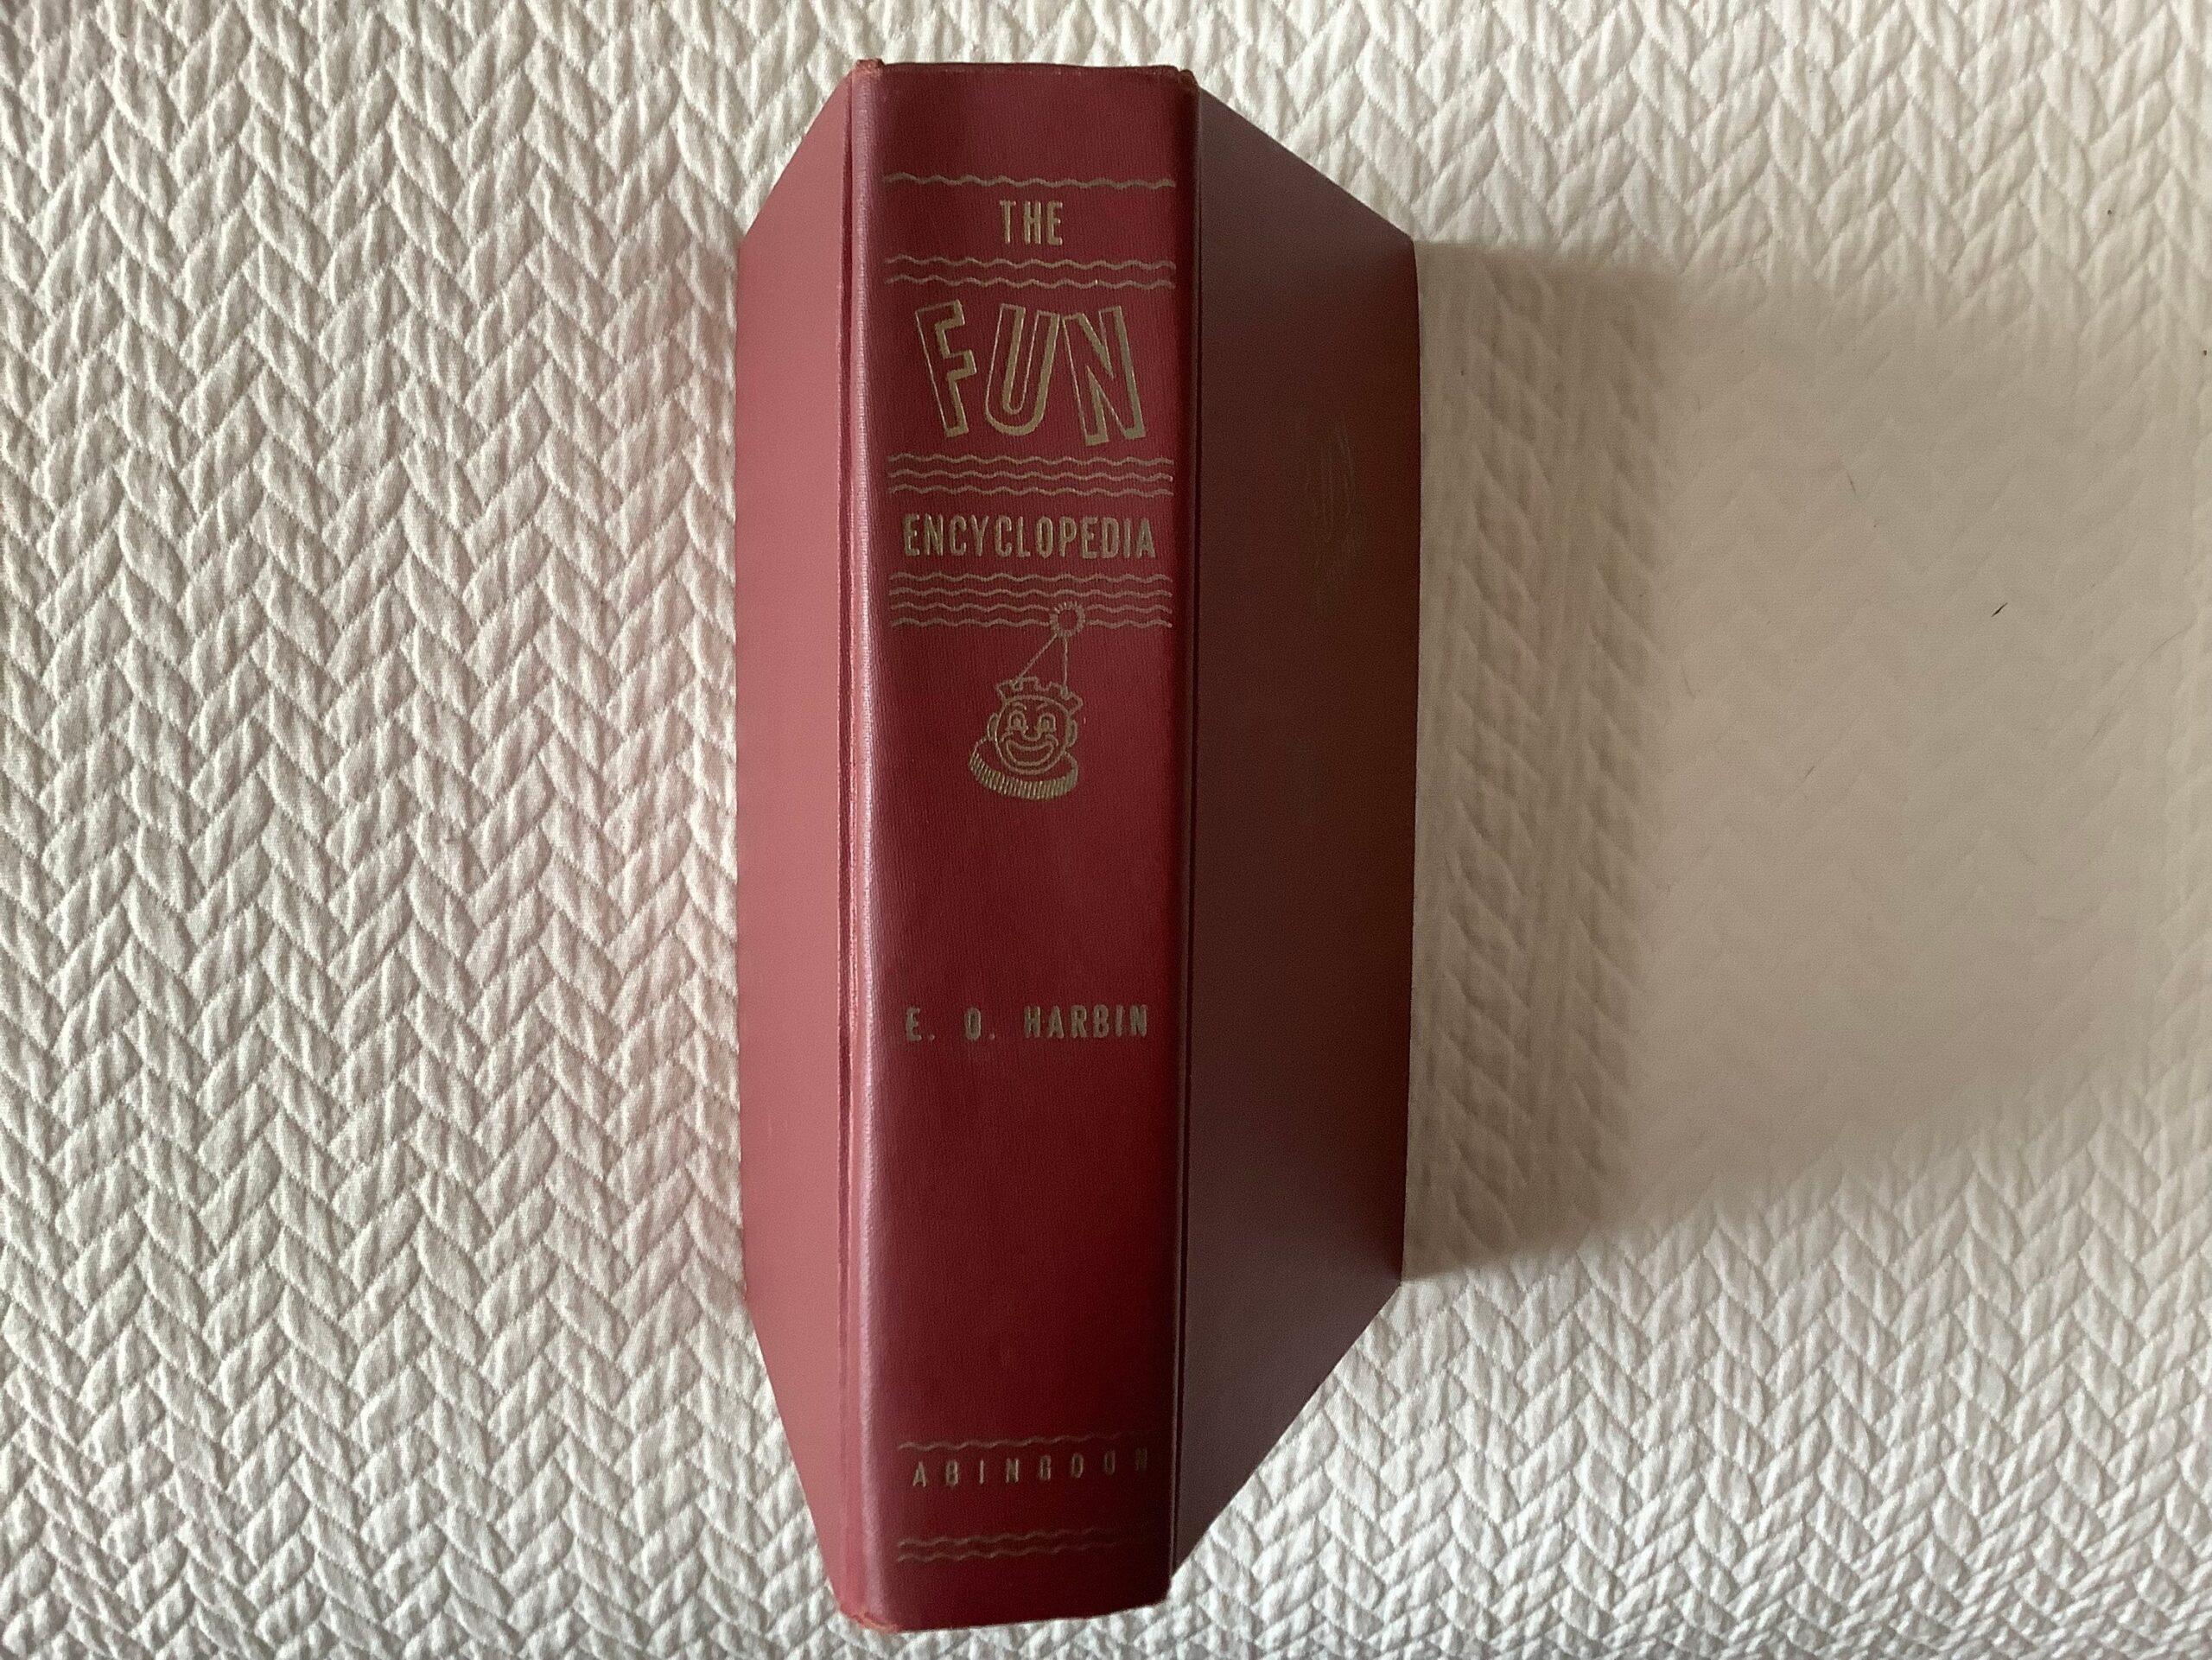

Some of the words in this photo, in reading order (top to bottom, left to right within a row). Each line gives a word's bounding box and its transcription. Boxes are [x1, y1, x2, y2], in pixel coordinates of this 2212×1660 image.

[1000, 200, 1064, 245] THE
[915, 299, 1147, 446] FUN
[904, 513, 1155, 558] ENCYCLOPEDIA
[906, 1007, 935, 1041] E.
[964, 1007, 995, 1041] O.
[1024, 1004, 1148, 1039] HARBIN
